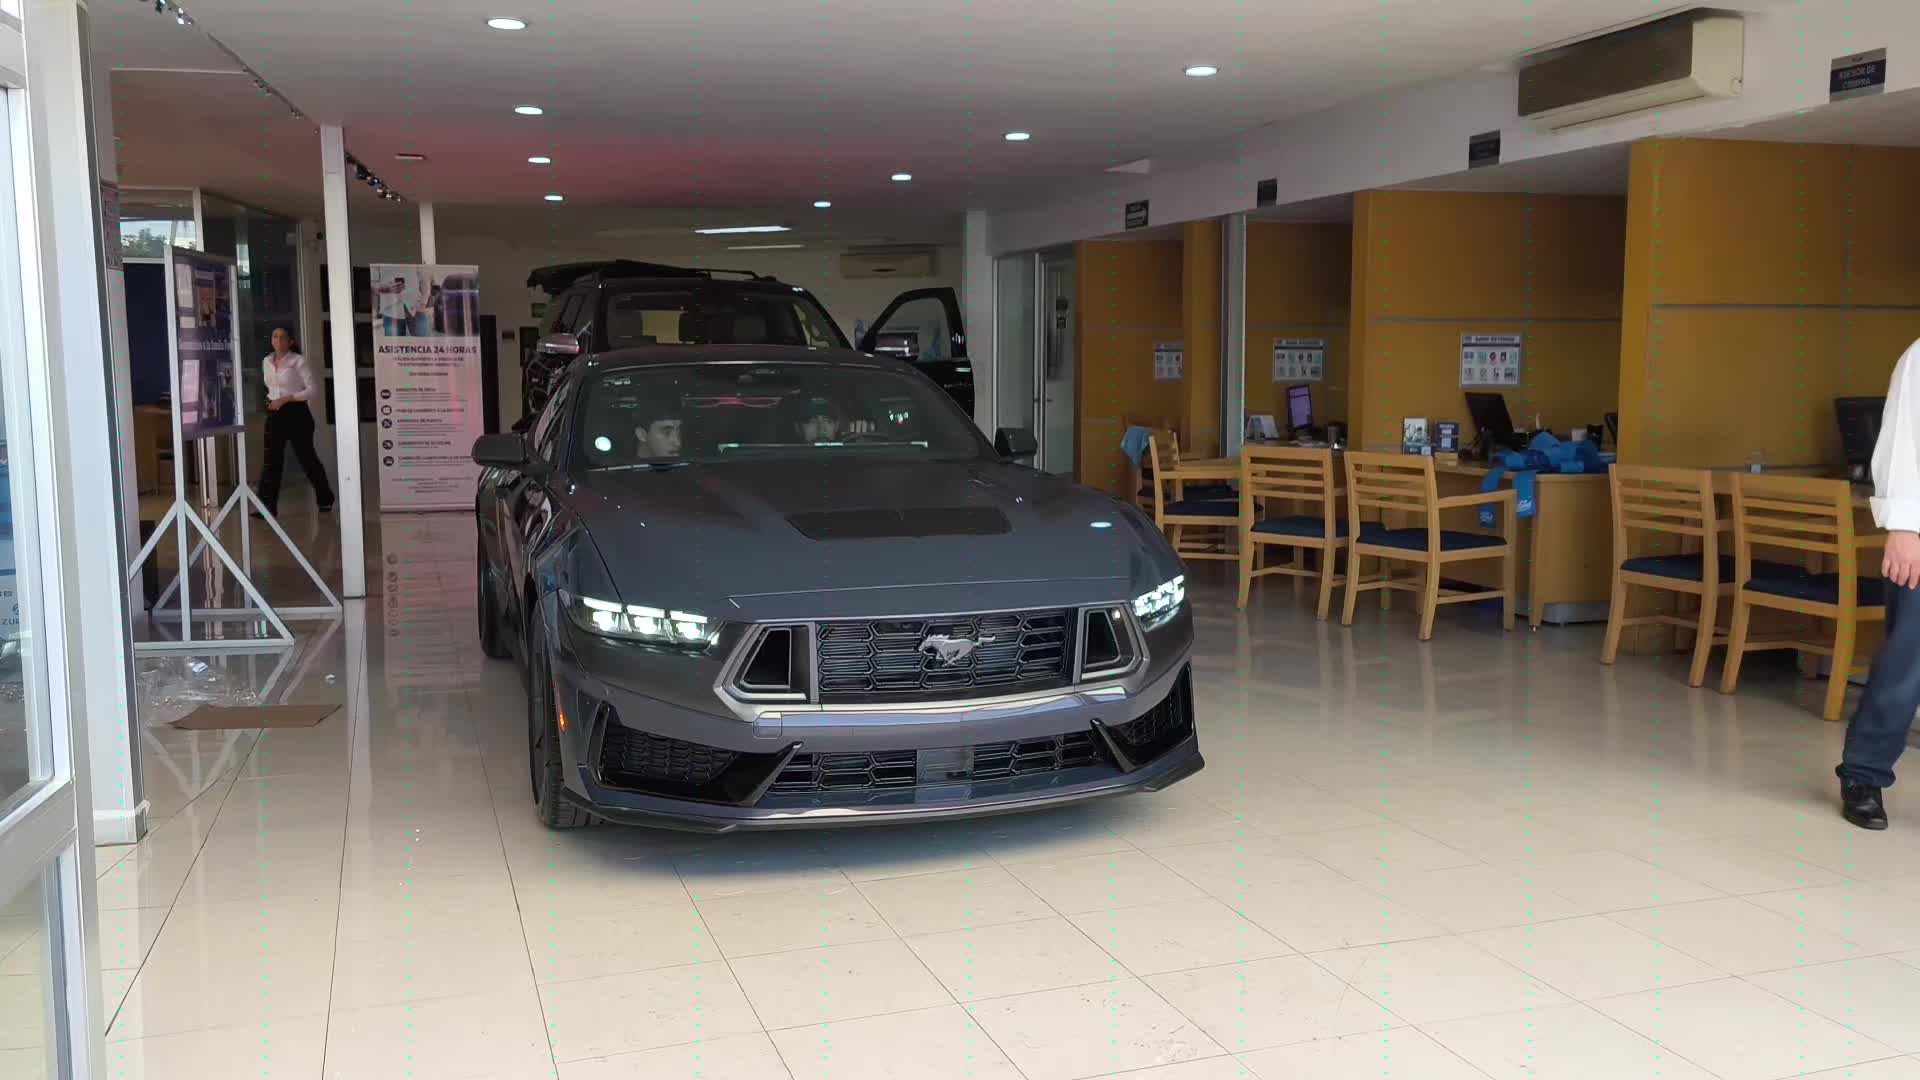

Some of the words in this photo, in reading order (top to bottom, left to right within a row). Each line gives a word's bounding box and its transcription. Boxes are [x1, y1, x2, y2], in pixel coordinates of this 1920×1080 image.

[378, 345, 432, 354] ASISTENCIA
[434, 346, 444, 354] 24
[446, 346, 477, 354] HORAS
